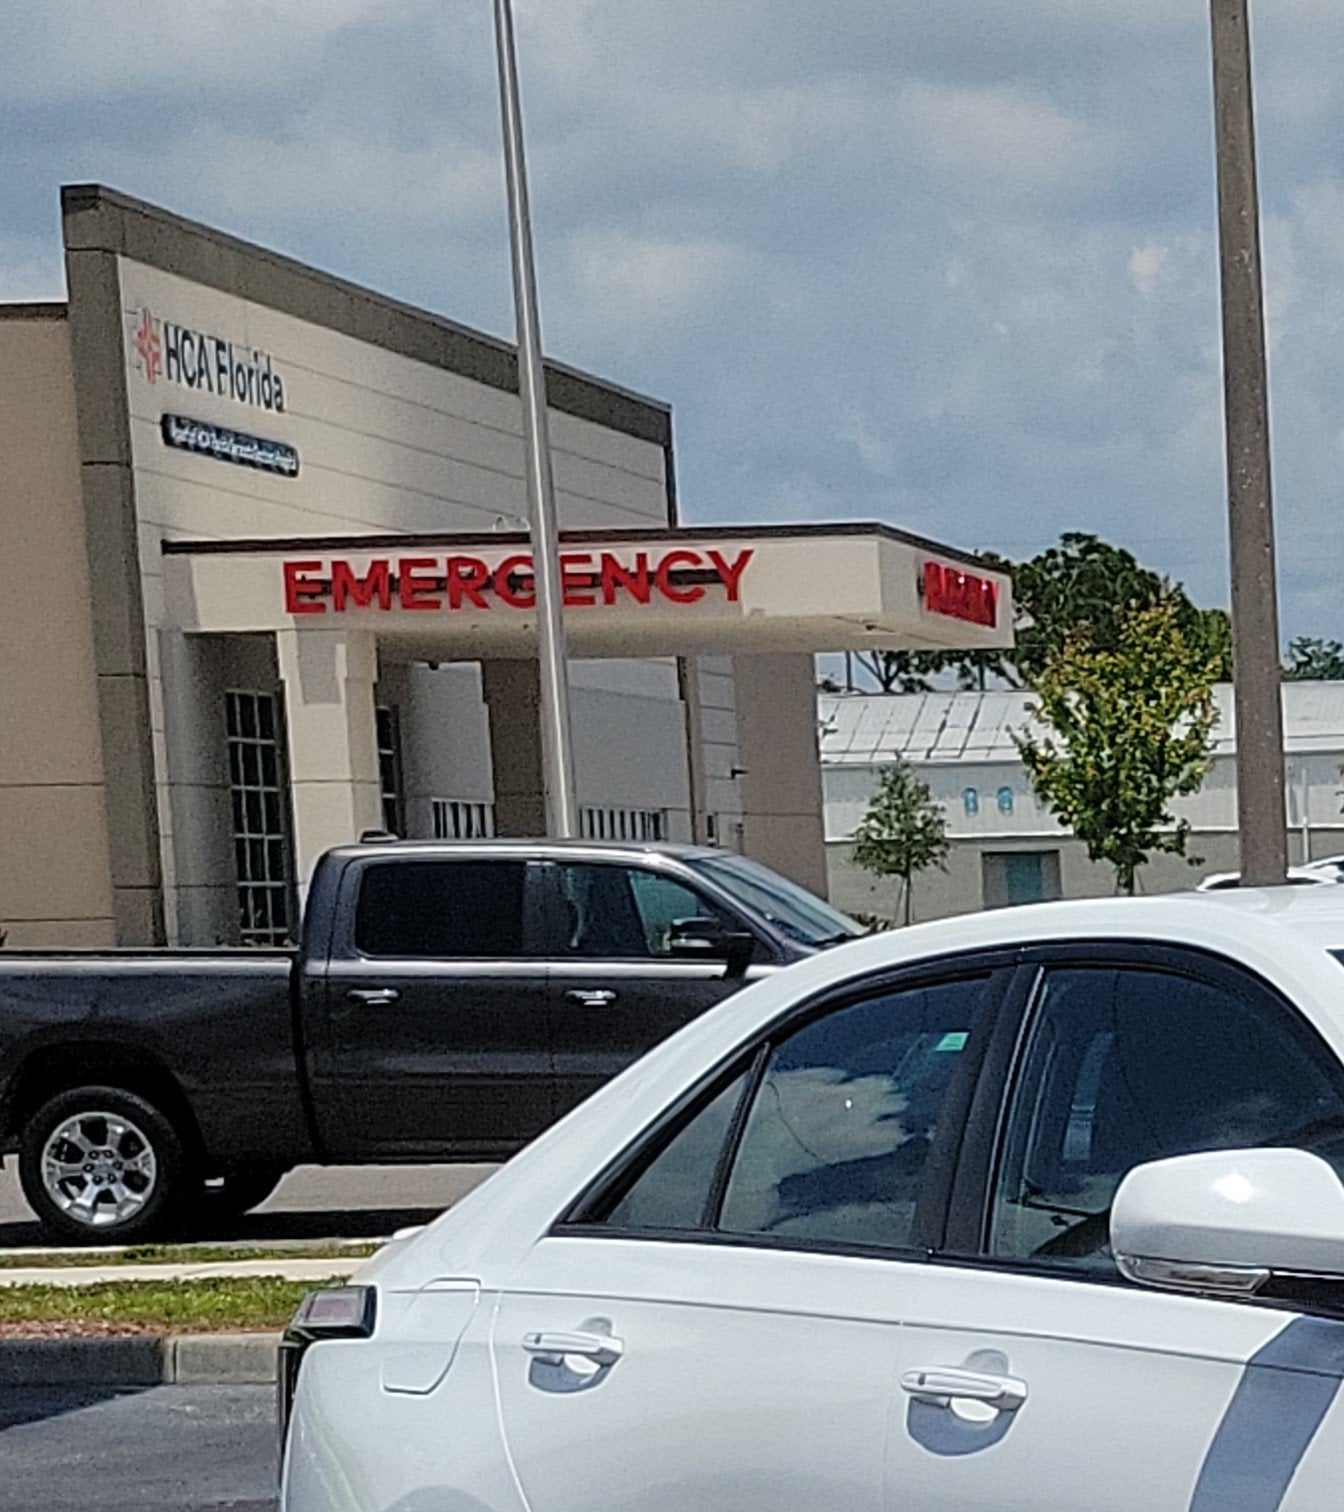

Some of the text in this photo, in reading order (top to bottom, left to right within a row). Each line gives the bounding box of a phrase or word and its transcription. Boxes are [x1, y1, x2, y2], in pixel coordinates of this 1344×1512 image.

[164, 322, 285, 413] HCA Florida
[283, 549, 755, 613] EMERGENCY
